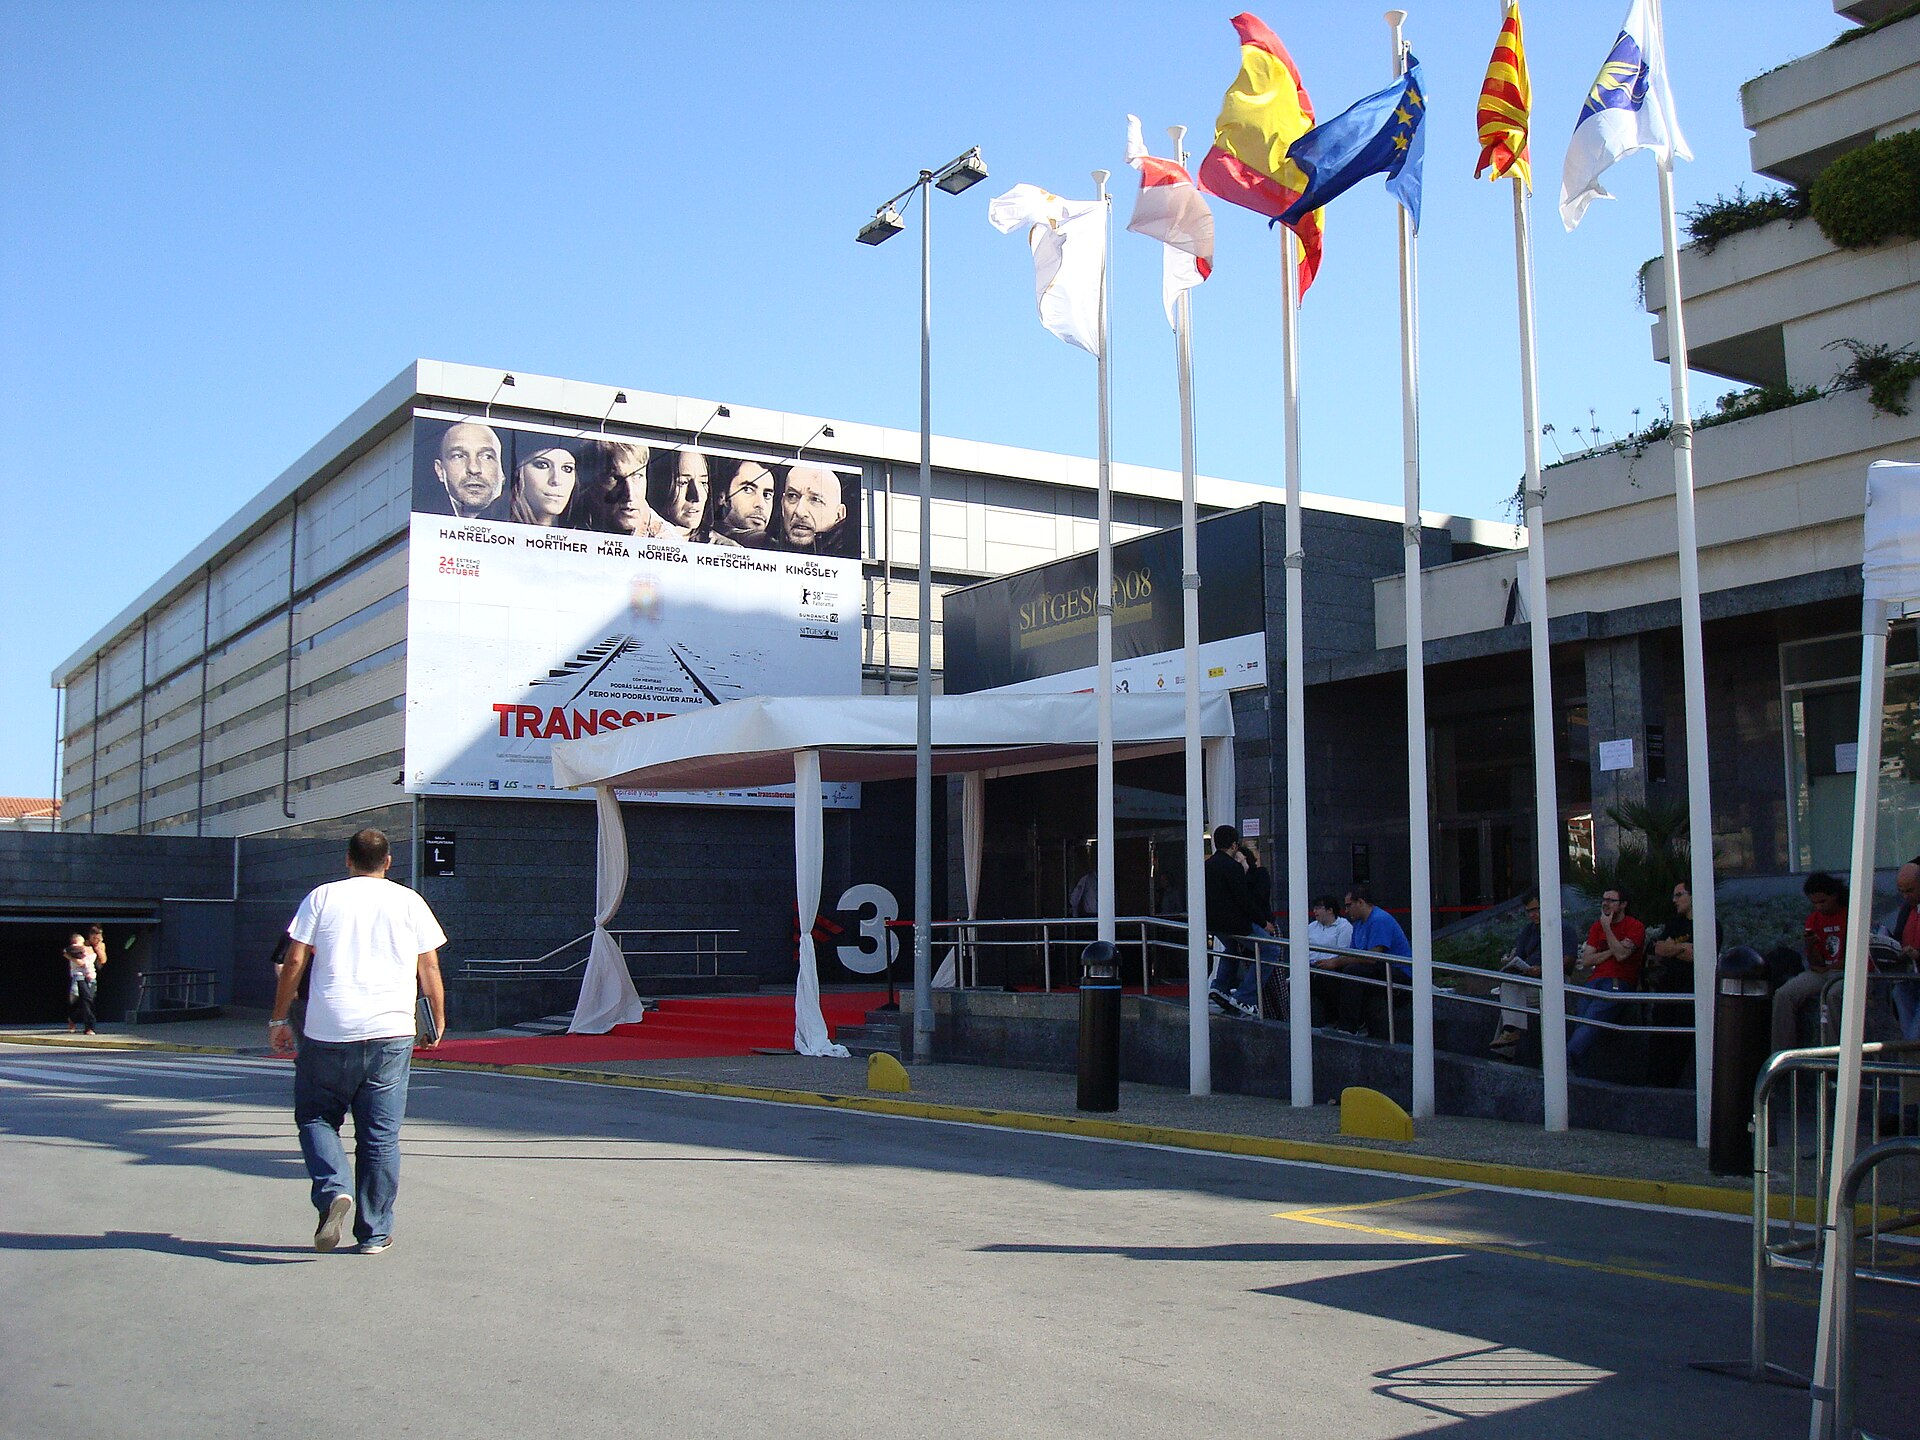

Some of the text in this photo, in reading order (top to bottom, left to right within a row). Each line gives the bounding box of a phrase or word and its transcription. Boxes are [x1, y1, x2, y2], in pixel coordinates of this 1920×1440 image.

[464, 525, 491, 533] WOODY
[440, 529, 515, 545] HARRELSON
[546, 534, 568, 542] EMILY
[526, 539, 588, 553] MORTIMER
[604, 540, 623, 548] KATE
[647, 544, 680, 553] EDUARDO
[597, 546, 630, 558] MARA
[638, 550, 688, 564] NORIEGA
[723, 552, 751, 561] THOMAS
[440, 556, 454, 566] 24
[697, 556, 777, 573] KRETSCHMANN
[439, 567, 480, 577] OCTUBRE
[785, 565, 839, 579] KINGSLEY
[589, 690, 703, 704] PERO NO PODRÁS VOLVER ATRÁS
[836, 883, 900, 974] 3
